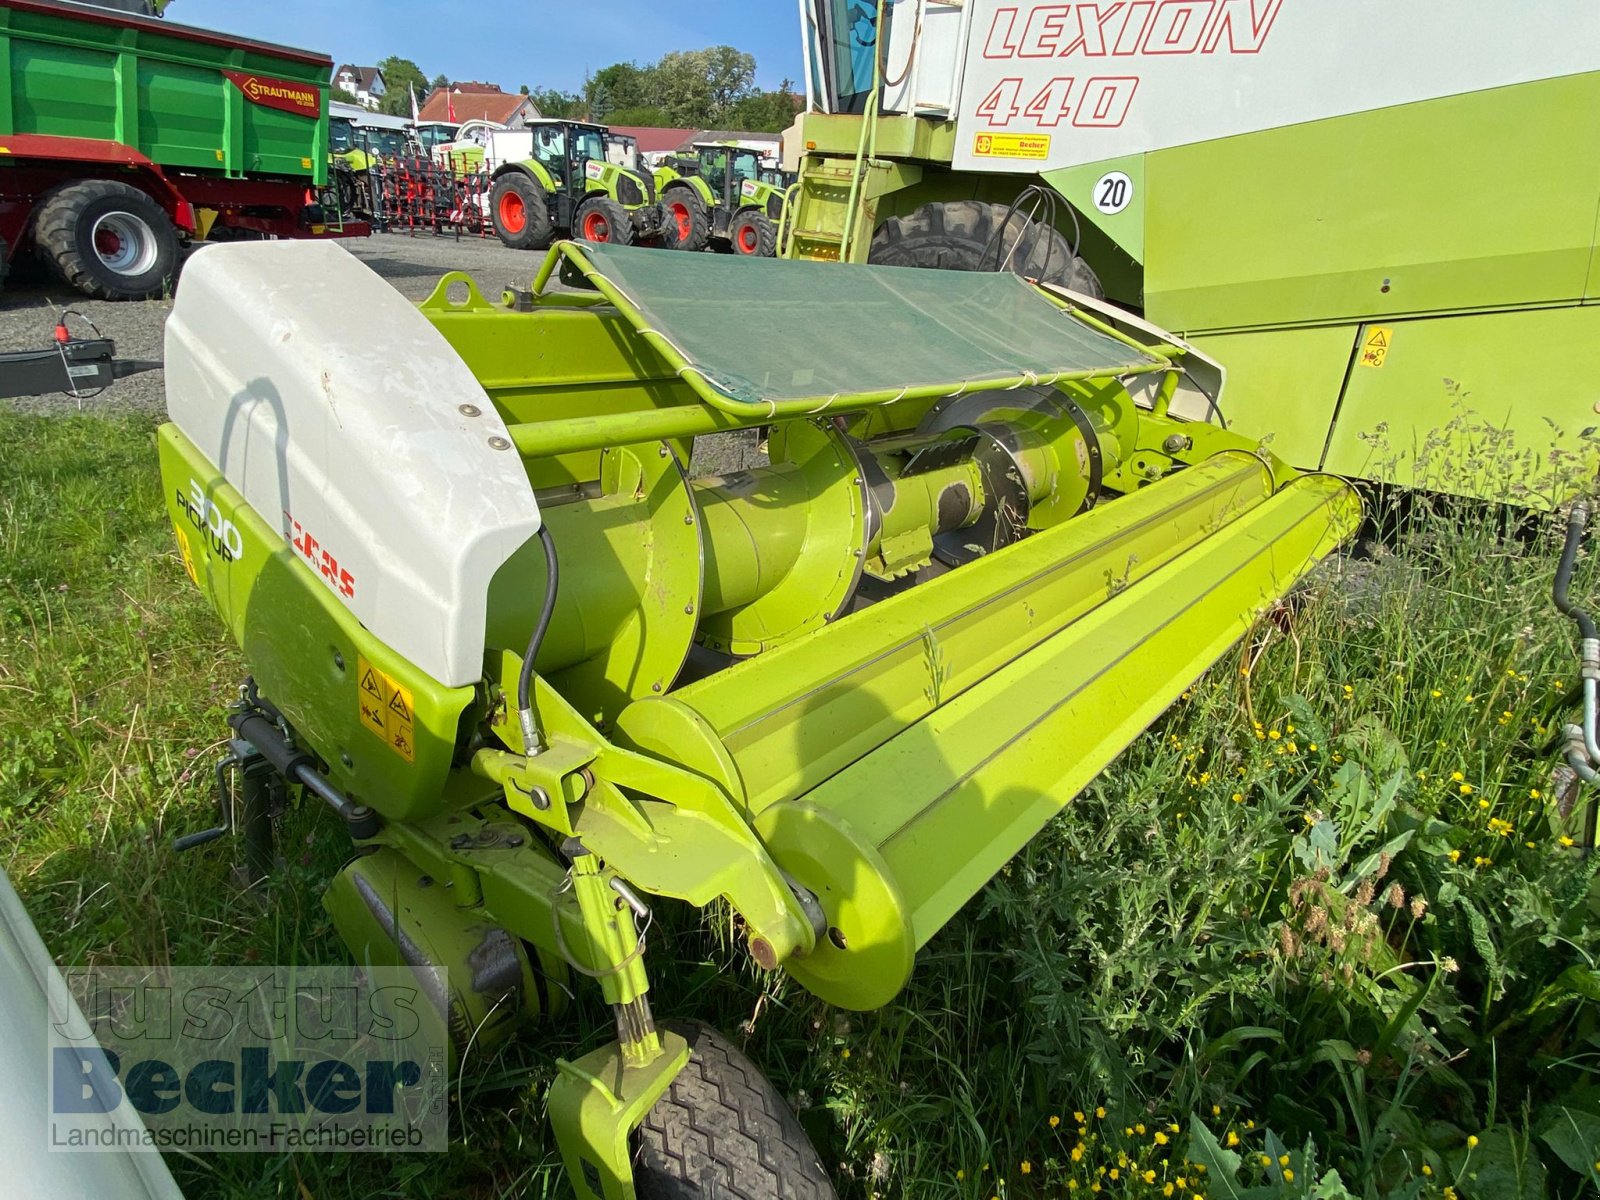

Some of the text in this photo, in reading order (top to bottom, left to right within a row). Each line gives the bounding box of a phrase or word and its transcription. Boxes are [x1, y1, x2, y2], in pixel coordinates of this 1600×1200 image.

[983, 0, 1284, 59] LEXION
[250, 83, 315, 103] STRAUTMANN
[975, 76, 1140, 128] 440
[1099, 178, 1126, 207] 20
[189, 477, 243, 560] 300
